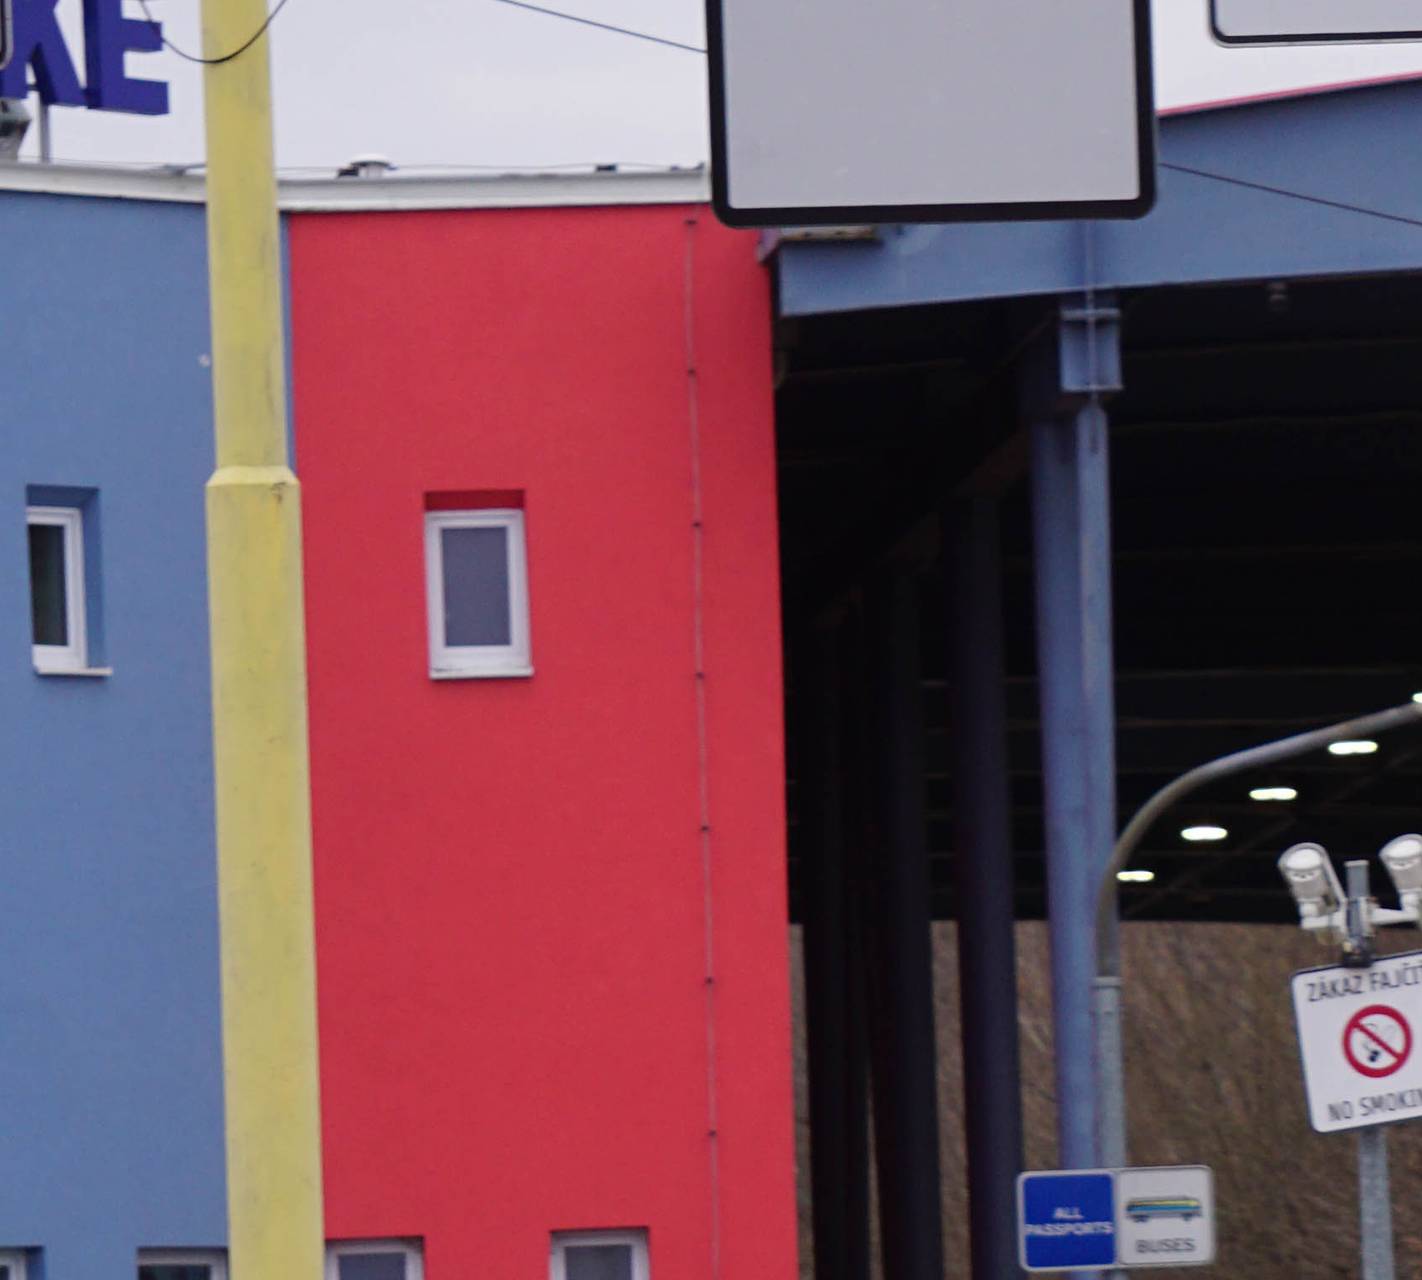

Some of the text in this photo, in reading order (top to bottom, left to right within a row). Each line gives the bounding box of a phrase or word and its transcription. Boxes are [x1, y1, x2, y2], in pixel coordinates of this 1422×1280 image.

[1306, 974, 1363, 1002] ZÁKAZ
[1327, 1100, 1354, 1122] NO
[1053, 1206, 1085, 1220] ALL
[1024, 1221, 1114, 1236] PASSPORTS
[1135, 1237, 1196, 1254] BUSES
